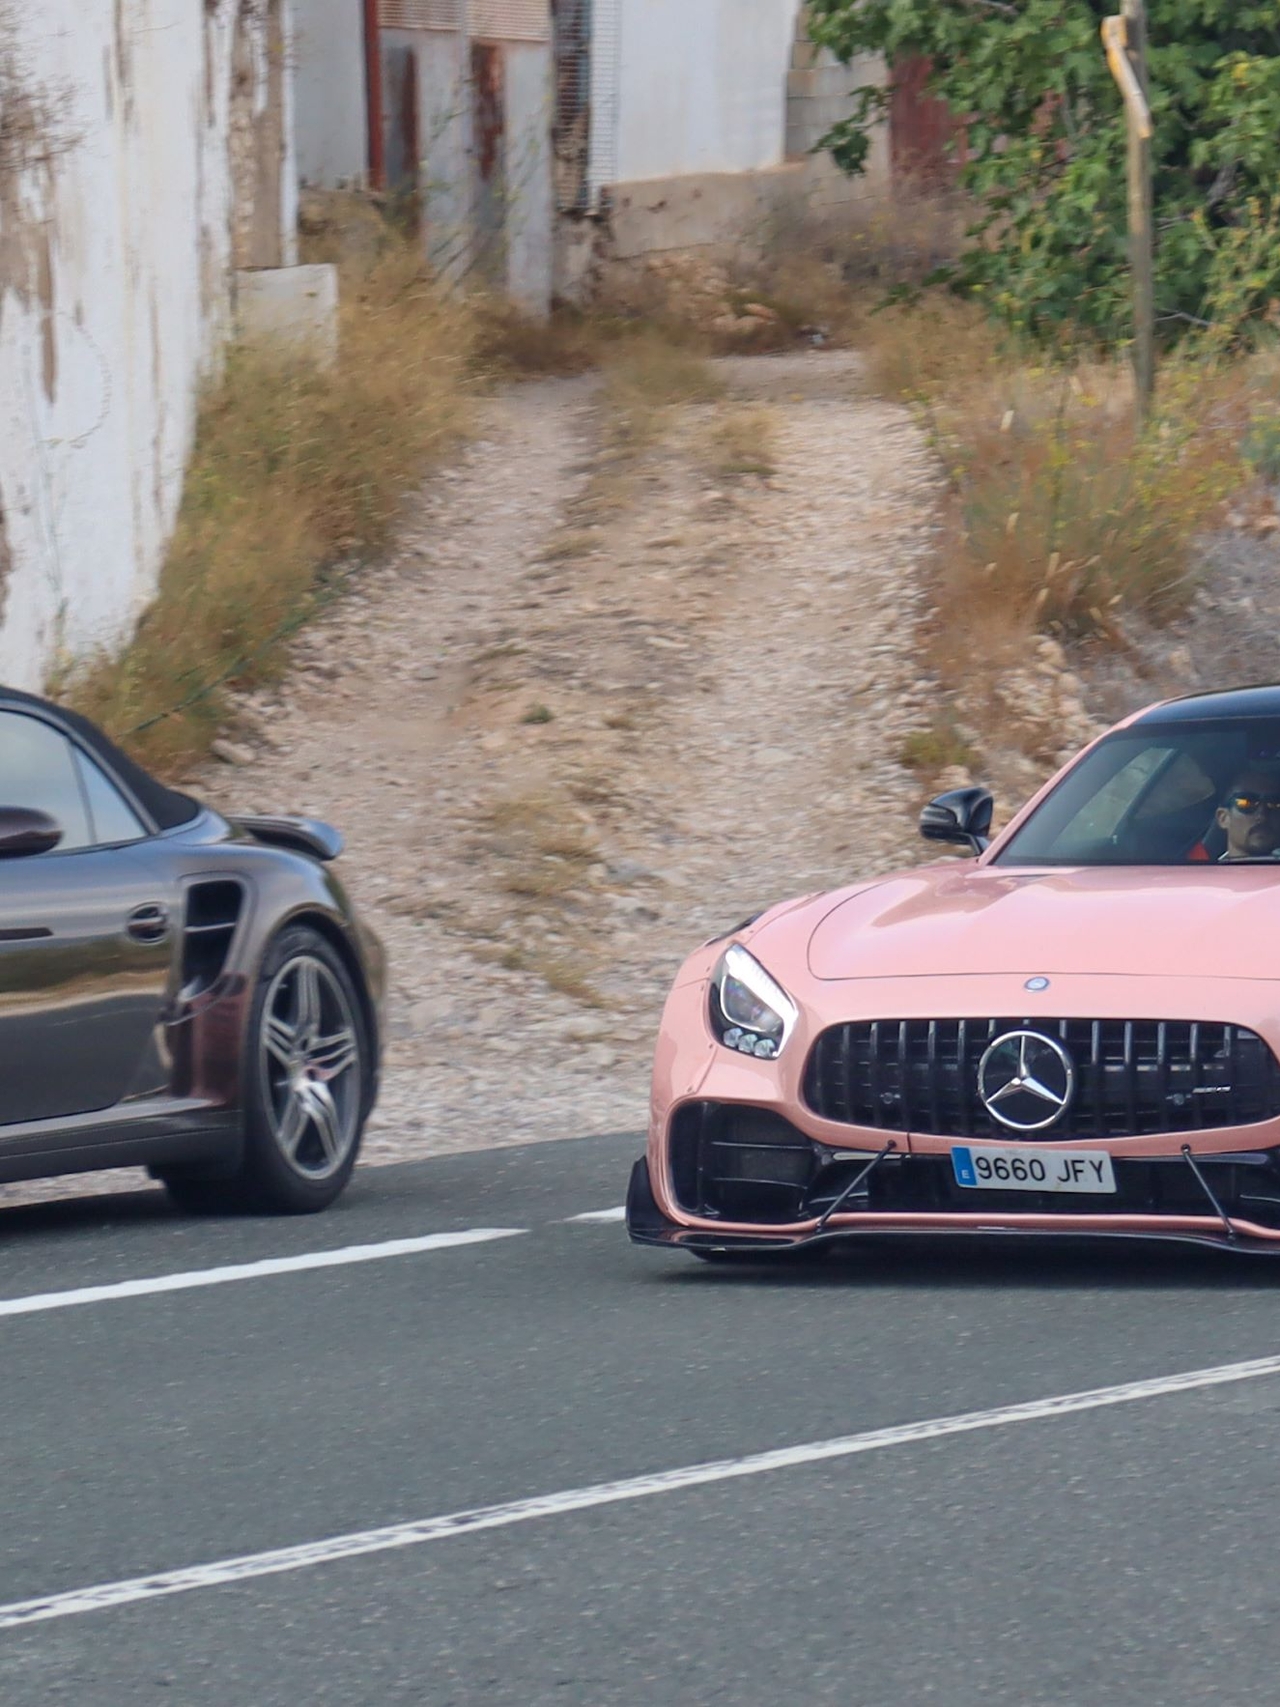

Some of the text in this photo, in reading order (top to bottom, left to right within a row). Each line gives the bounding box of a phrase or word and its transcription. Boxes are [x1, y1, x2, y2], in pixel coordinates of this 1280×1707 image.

[961, 1169, 970, 1179] E
[975, 1156, 1104, 1183] 9660 JFY
